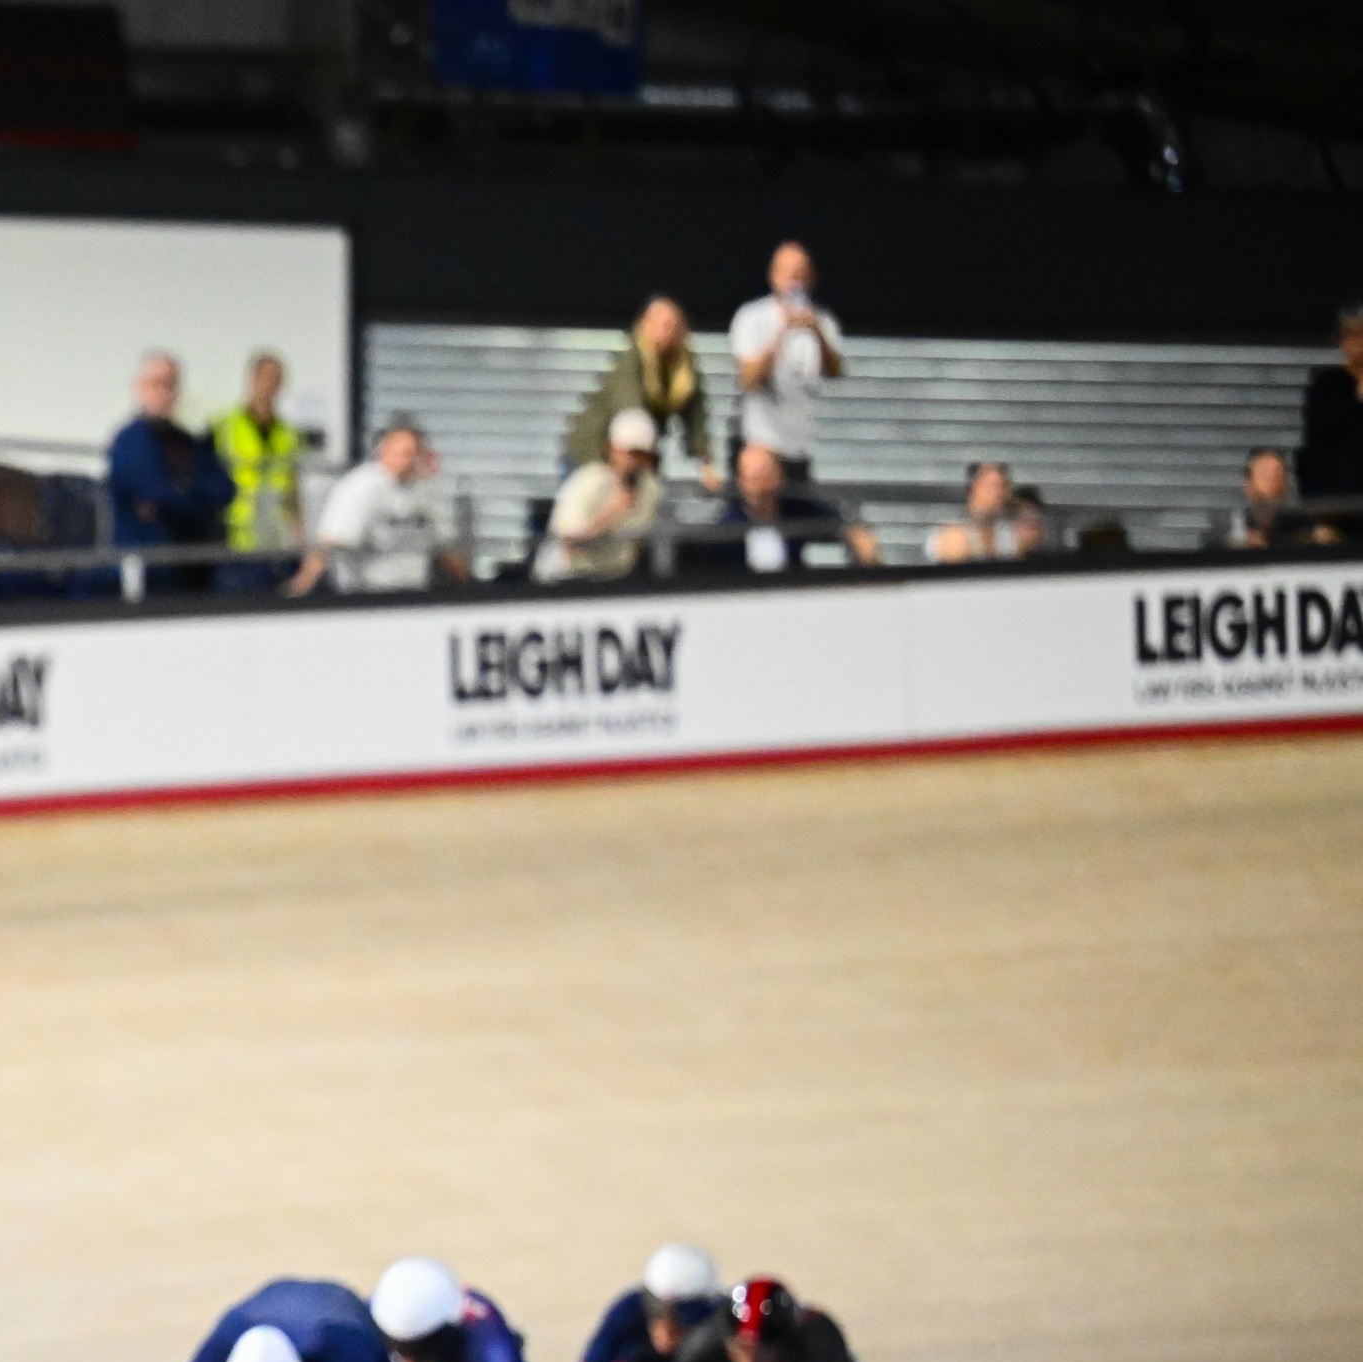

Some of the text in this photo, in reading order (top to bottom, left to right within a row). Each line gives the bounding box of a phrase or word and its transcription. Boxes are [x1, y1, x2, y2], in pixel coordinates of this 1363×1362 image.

[449, 622, 682, 704] LEIGH DAY
[1135, 585, 1363, 665] LEIGH DA
